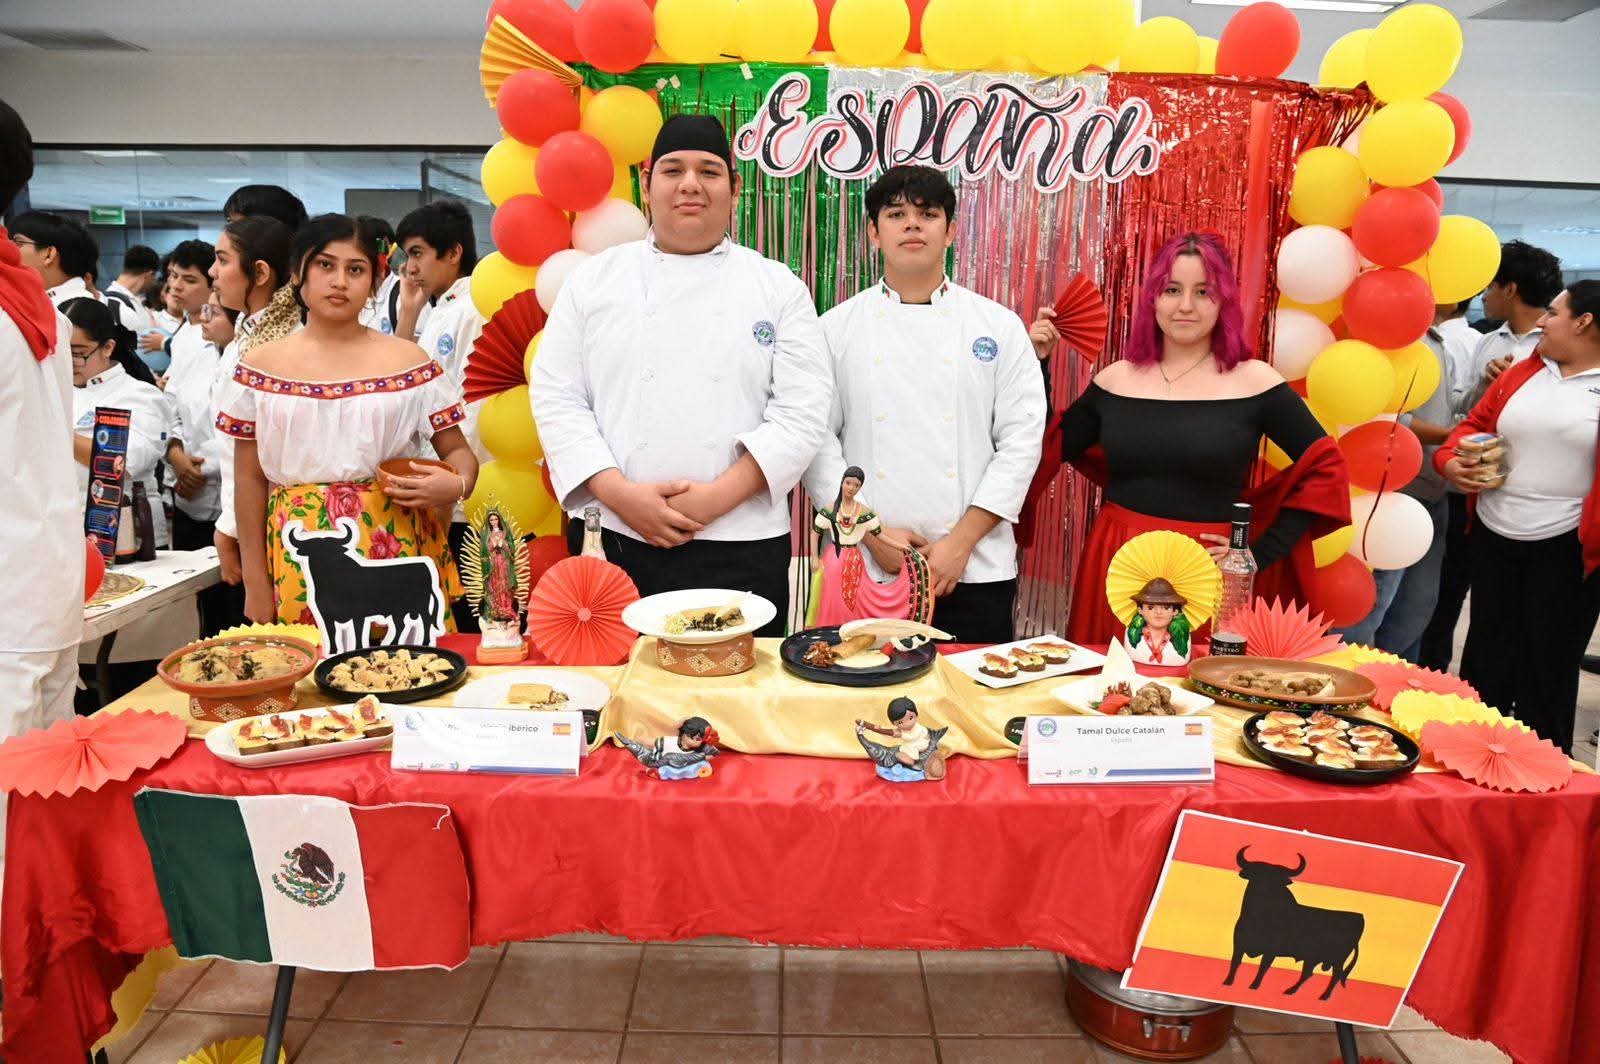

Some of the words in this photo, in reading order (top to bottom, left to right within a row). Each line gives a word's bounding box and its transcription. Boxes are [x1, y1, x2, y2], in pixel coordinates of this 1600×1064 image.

[737, 74, 1157, 190] España
[1077, 727, 1103, 735] Tamal
[1105, 727, 1131, 735] Dulce
[1133, 726, 1165, 735] Catalán
